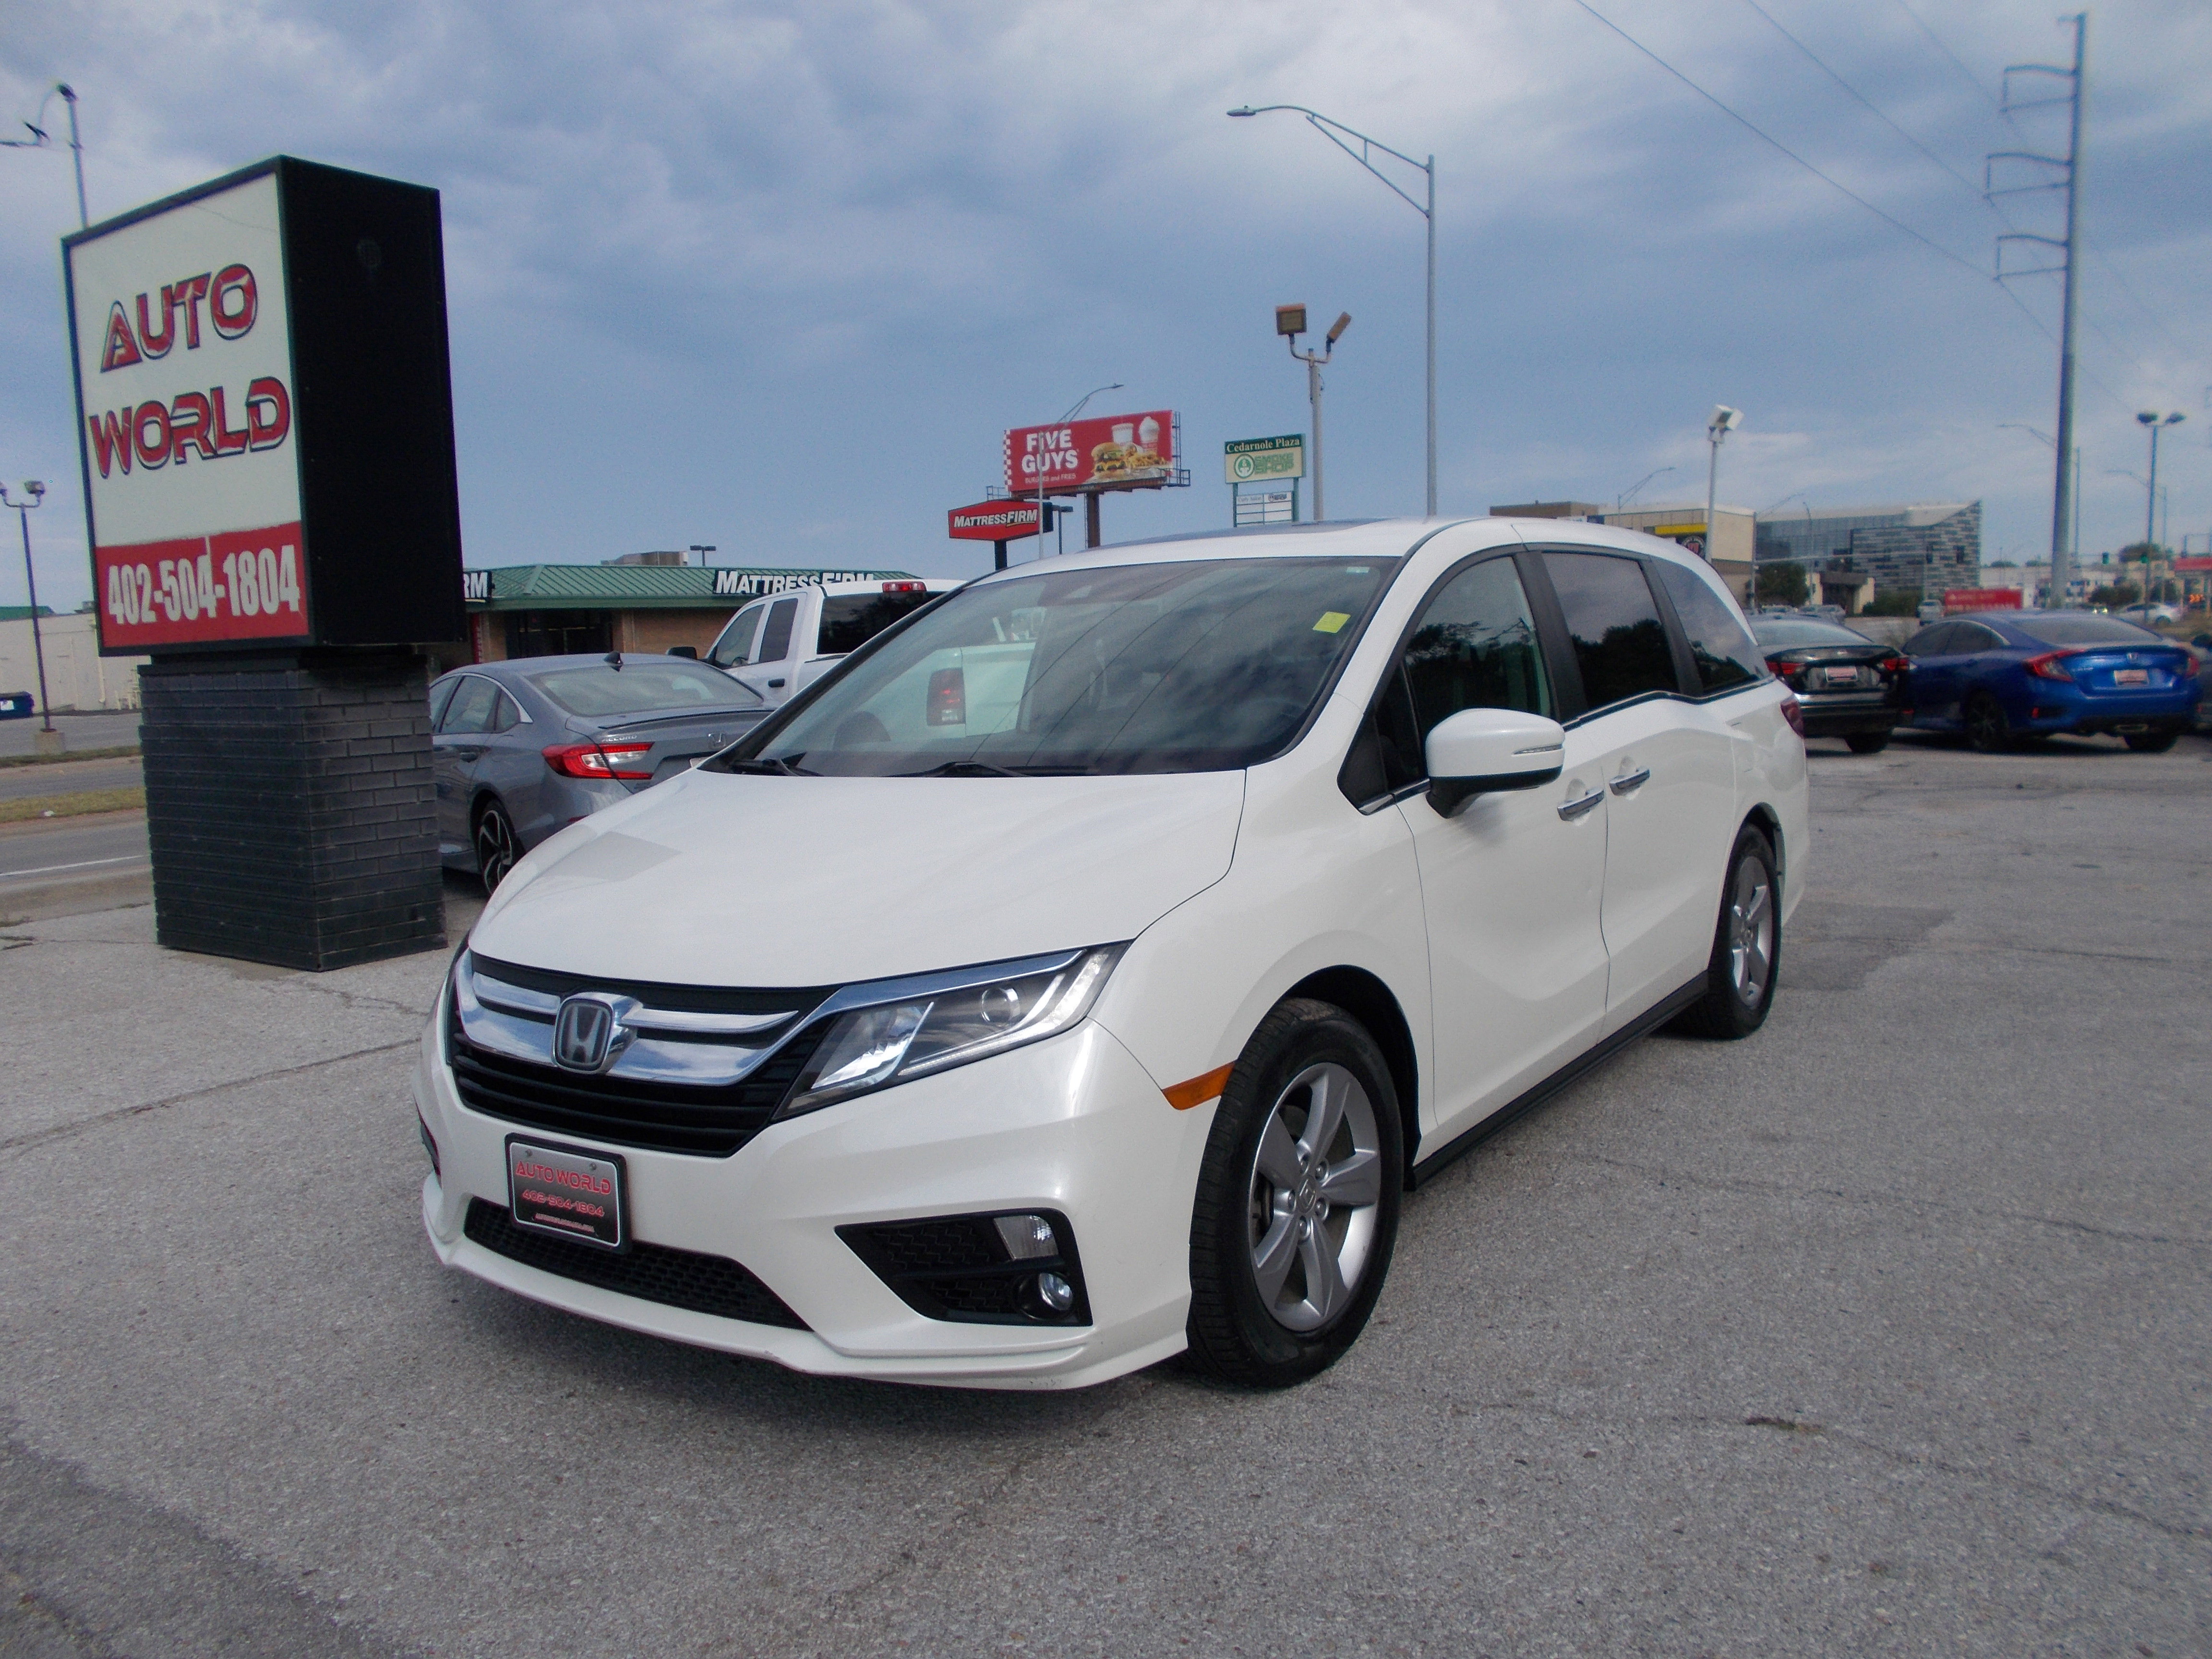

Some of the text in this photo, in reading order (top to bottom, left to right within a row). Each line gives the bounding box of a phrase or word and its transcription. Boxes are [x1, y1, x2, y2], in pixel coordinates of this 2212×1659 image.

[100, 264, 258, 372] AUTO
[89, 376, 291, 479] WORLD
[1227, 438, 1300, 452] Cedarnole Plaza
[1022, 449, 1078, 473] GUYS
[1025, 475, 1049, 483] BURGRS
[107, 544, 300, 625] 402-504-1804
[516, 1160, 611, 1195] AUTO WORLD
